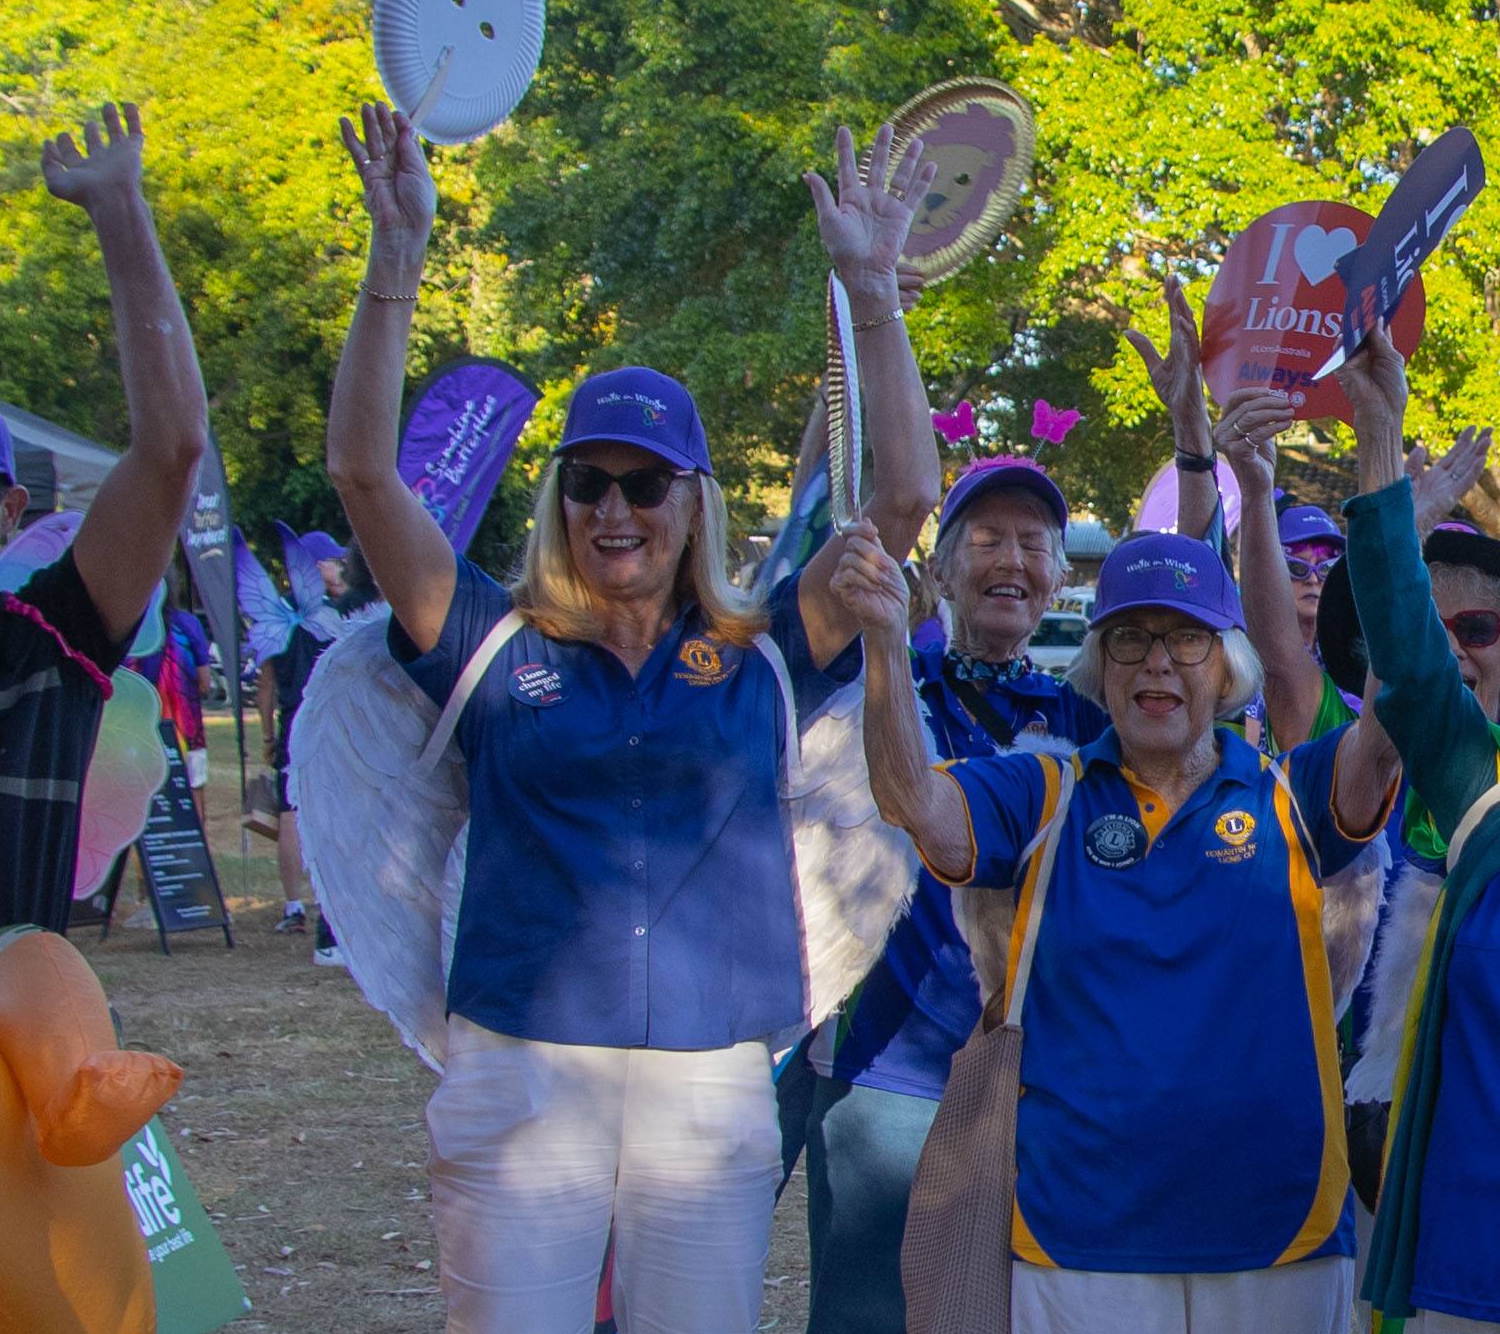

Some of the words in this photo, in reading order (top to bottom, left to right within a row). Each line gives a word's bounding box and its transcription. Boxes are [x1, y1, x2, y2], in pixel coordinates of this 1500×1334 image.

[1256, 223, 1295, 285] I
[1243, 296, 1344, 338] Lions
[1237, 360, 1320, 390] Always.
[425, 399, 477, 477] Sunshine
[518, 669, 549, 683] Lions
[518, 672, 561, 692] changed
[1229, 818, 1243, 834] L
[1109, 832, 1120, 847] L
